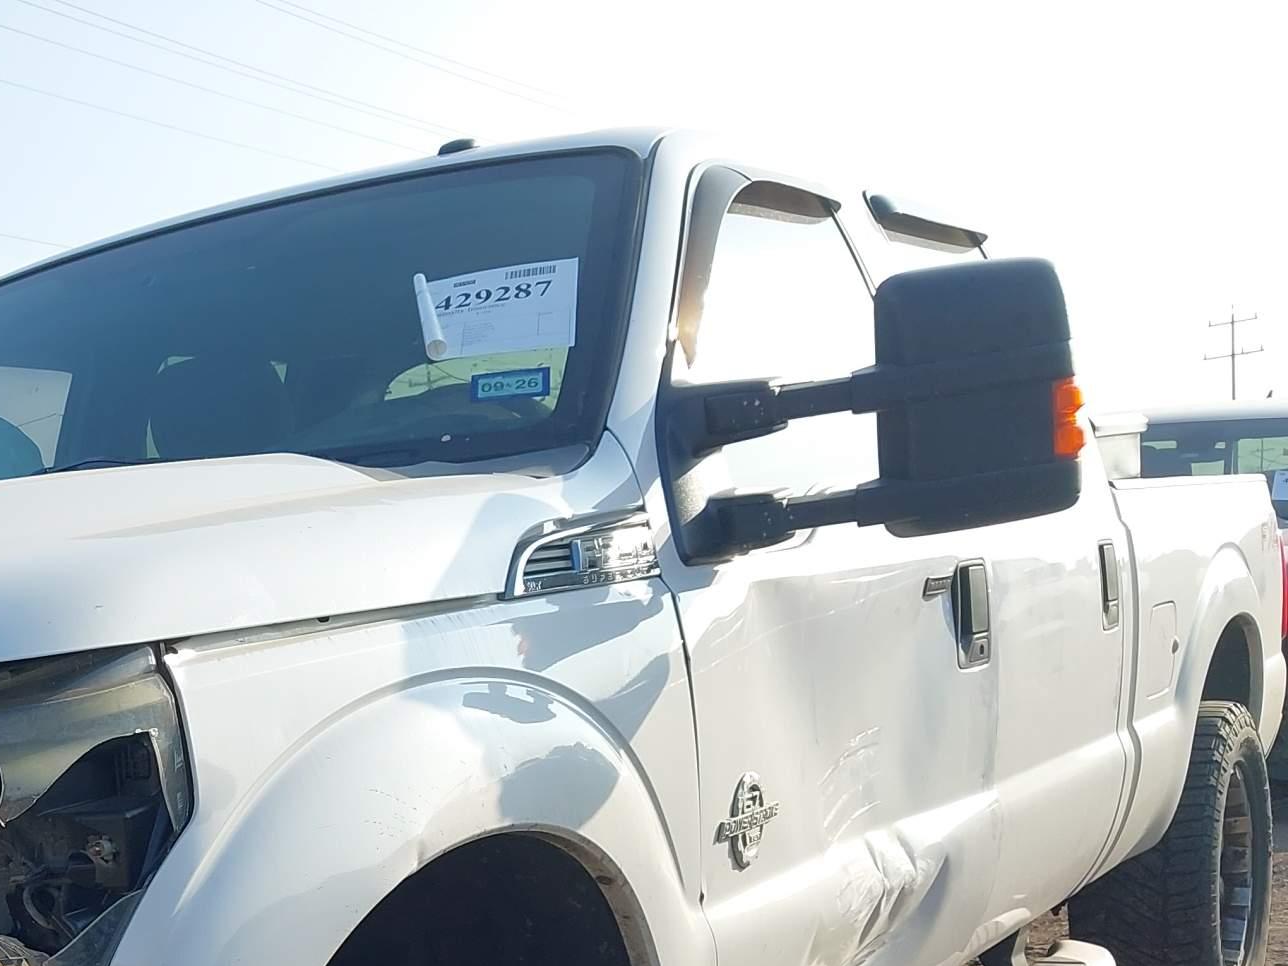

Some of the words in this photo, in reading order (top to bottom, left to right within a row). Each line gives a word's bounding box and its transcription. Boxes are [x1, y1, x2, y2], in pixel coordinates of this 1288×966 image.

[435, 279, 553, 311] 429287
[481, 381, 504, 393] 09
[515, 377, 538, 391] 26
